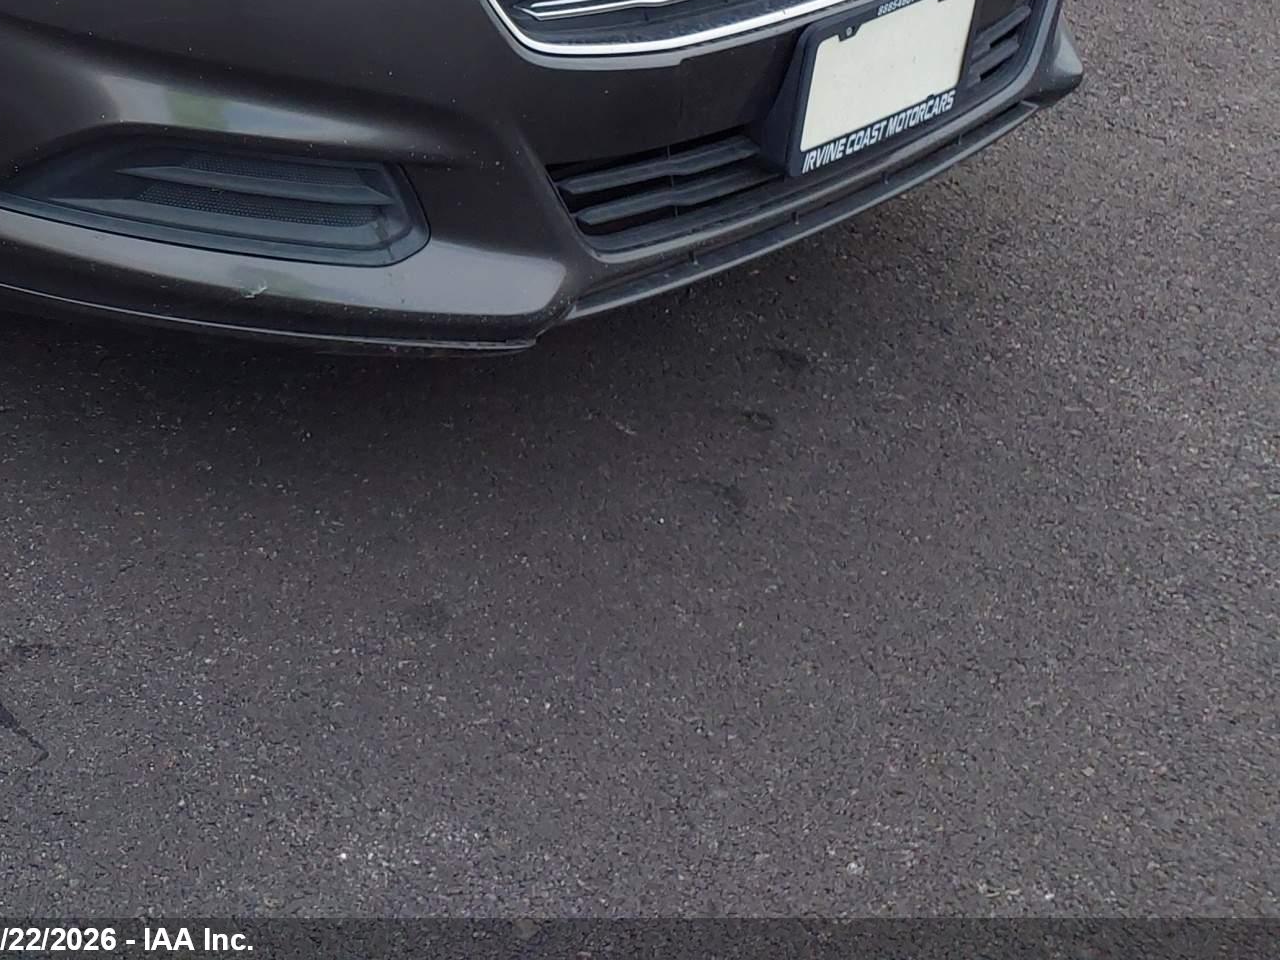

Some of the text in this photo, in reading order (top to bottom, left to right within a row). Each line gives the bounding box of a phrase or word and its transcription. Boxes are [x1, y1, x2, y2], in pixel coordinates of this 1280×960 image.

[802, 90, 956, 174] IRVINE COAST MOTORCARS
